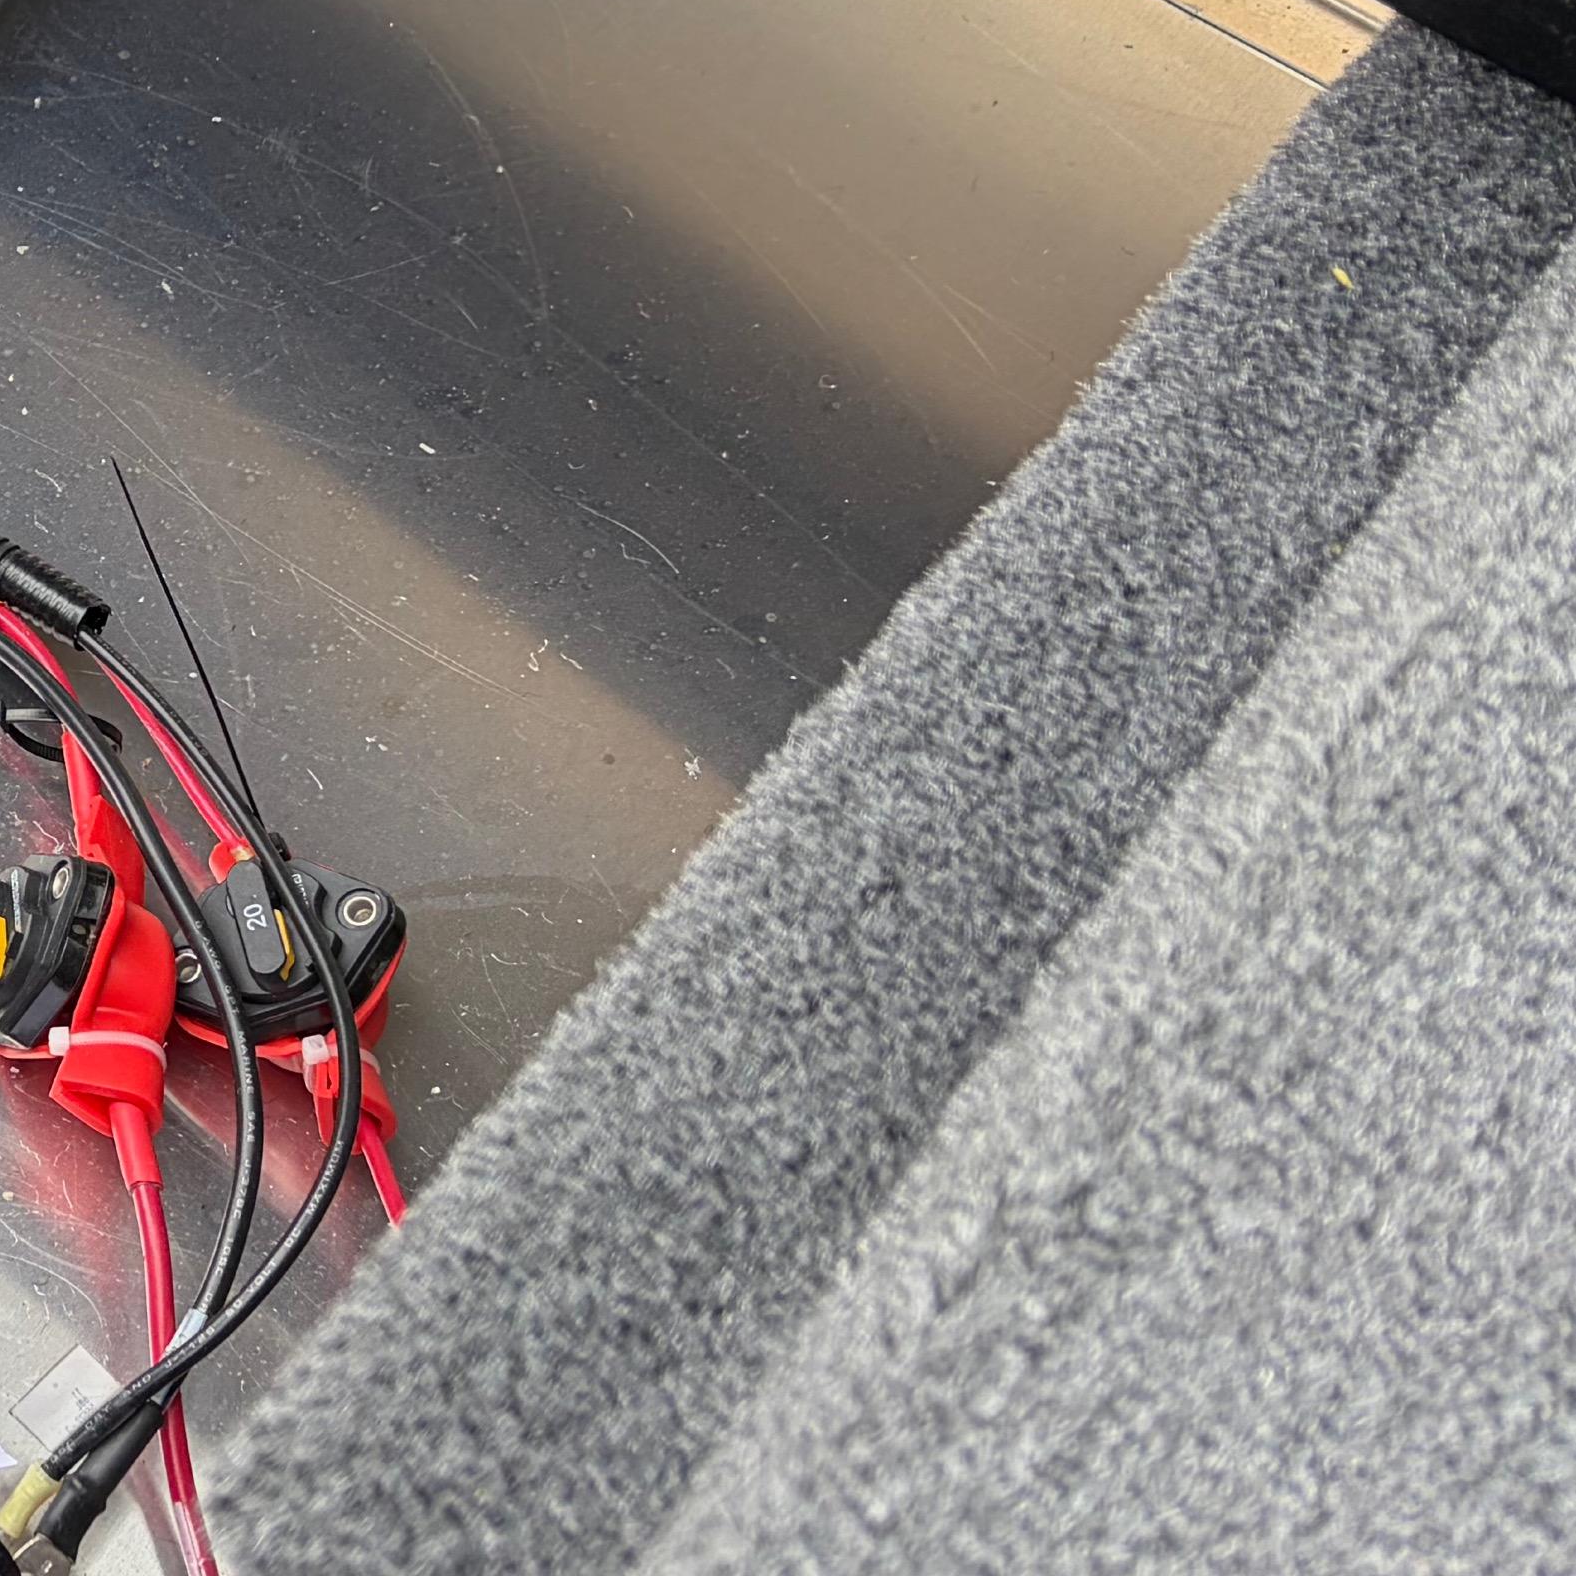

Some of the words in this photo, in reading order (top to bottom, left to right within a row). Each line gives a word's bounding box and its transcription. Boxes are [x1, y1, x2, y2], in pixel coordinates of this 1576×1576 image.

[244, 903, 268, 931] 20
[238, 1031, 255, 1095] MARINE
[247, 1111, 255, 1144] SAE
[246, 1260, 277, 1294] VOLT
[283, 1225, 302, 1248] DC
[306, 1140, 344, 1215] MAXIMUM
